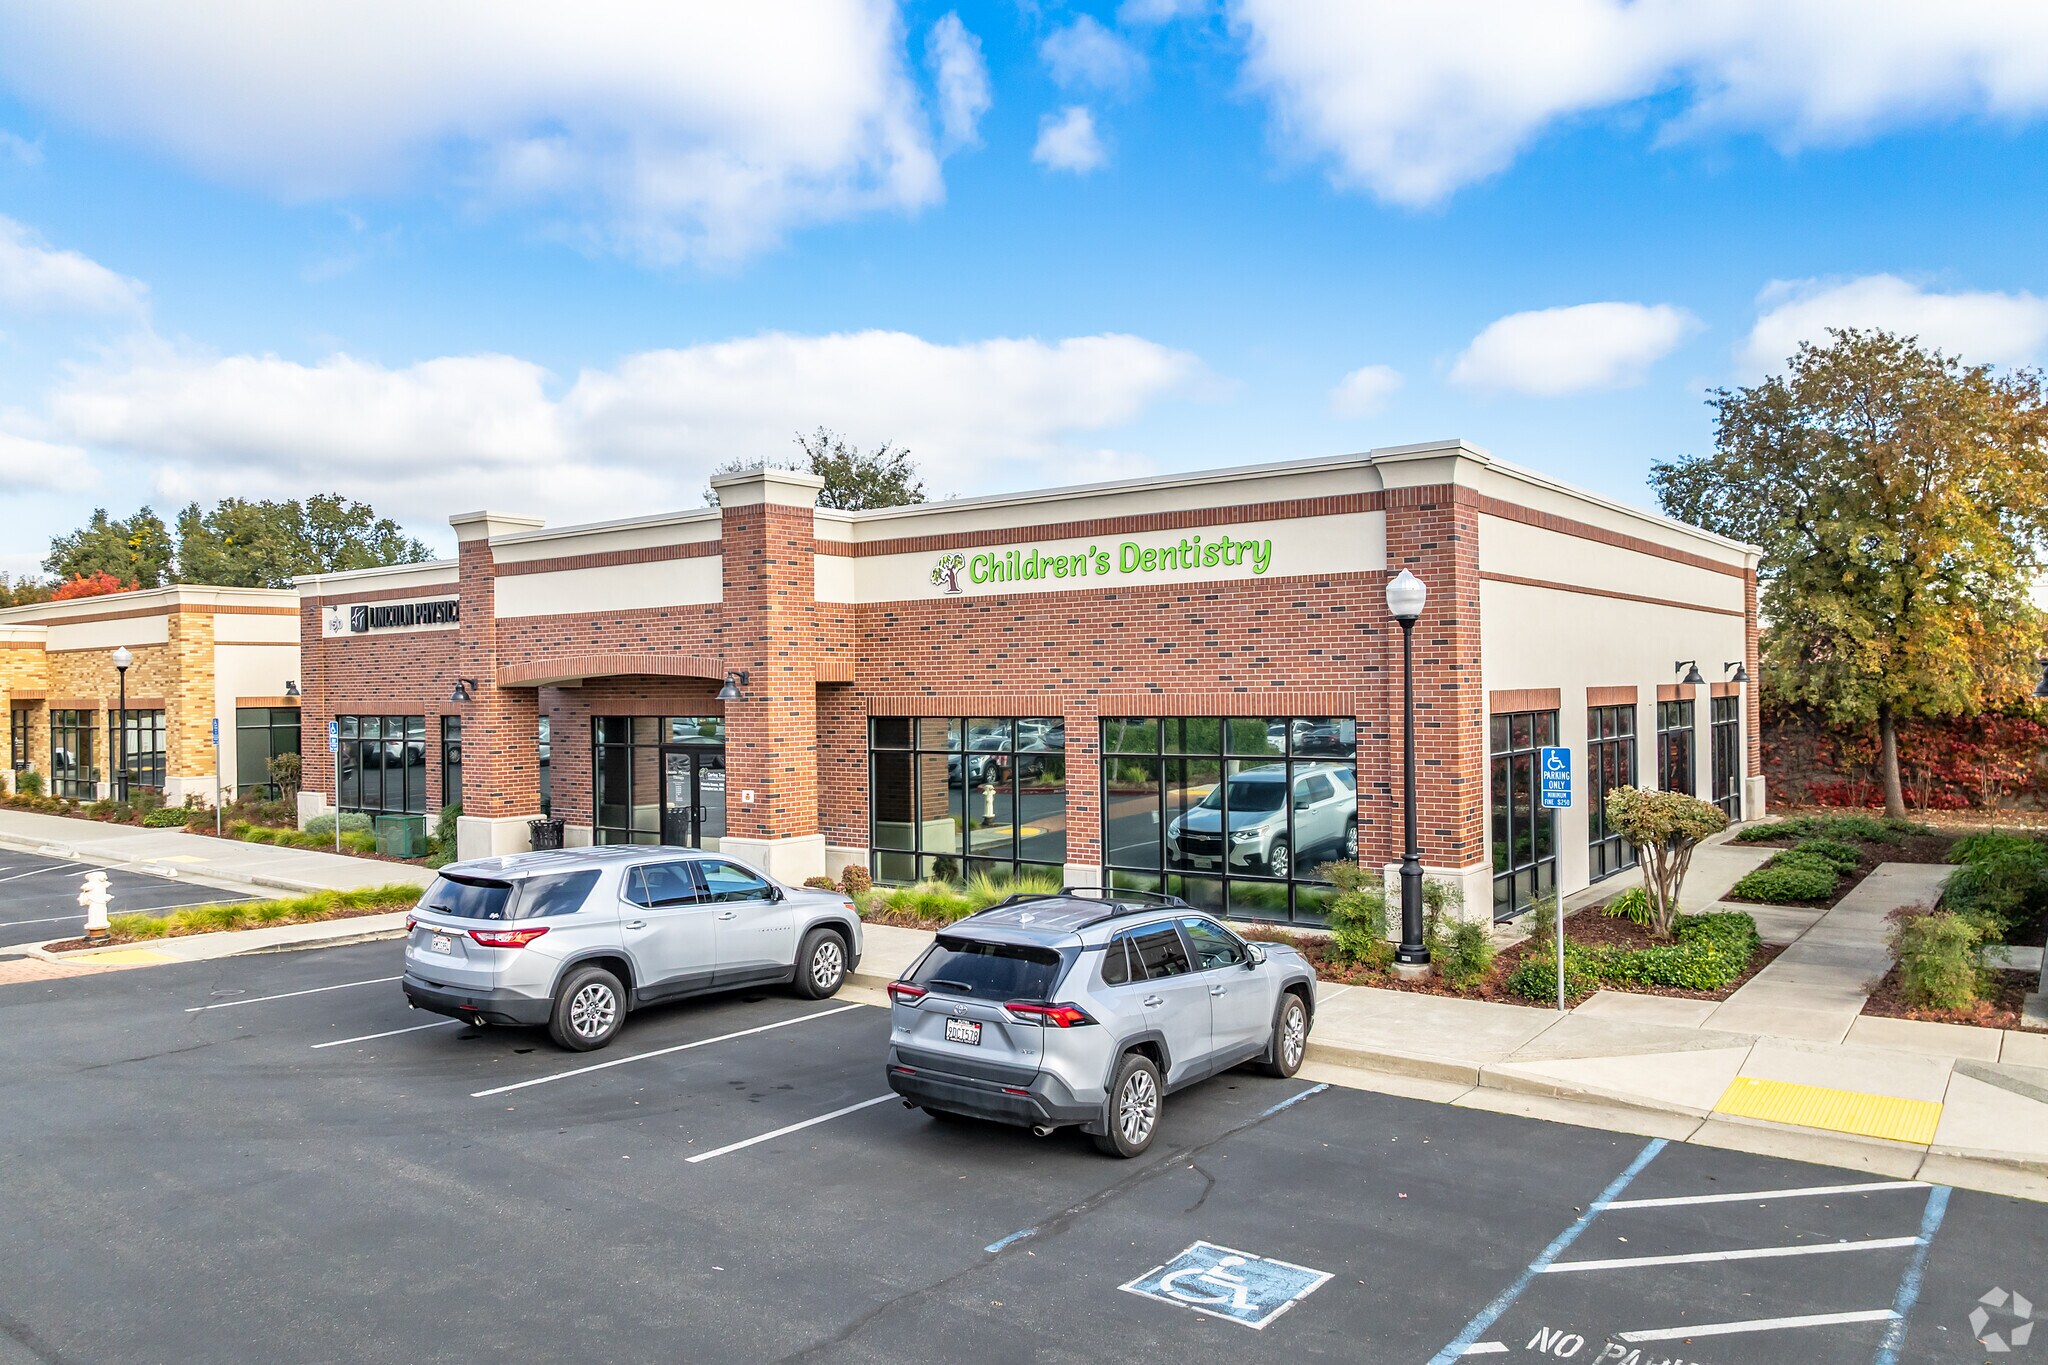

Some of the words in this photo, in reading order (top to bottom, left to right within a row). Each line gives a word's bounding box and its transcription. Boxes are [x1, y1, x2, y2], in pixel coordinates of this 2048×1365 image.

[969, 545, 1111, 585] Children's
[1119, 535, 1272, 574] Dentistry
[370, 604, 414, 628] LINCOLN
[1543, 771, 1570, 780] PARKING
[1549, 781, 1565, 789] ONLY
[1525, 1326, 1585, 1358] NO
